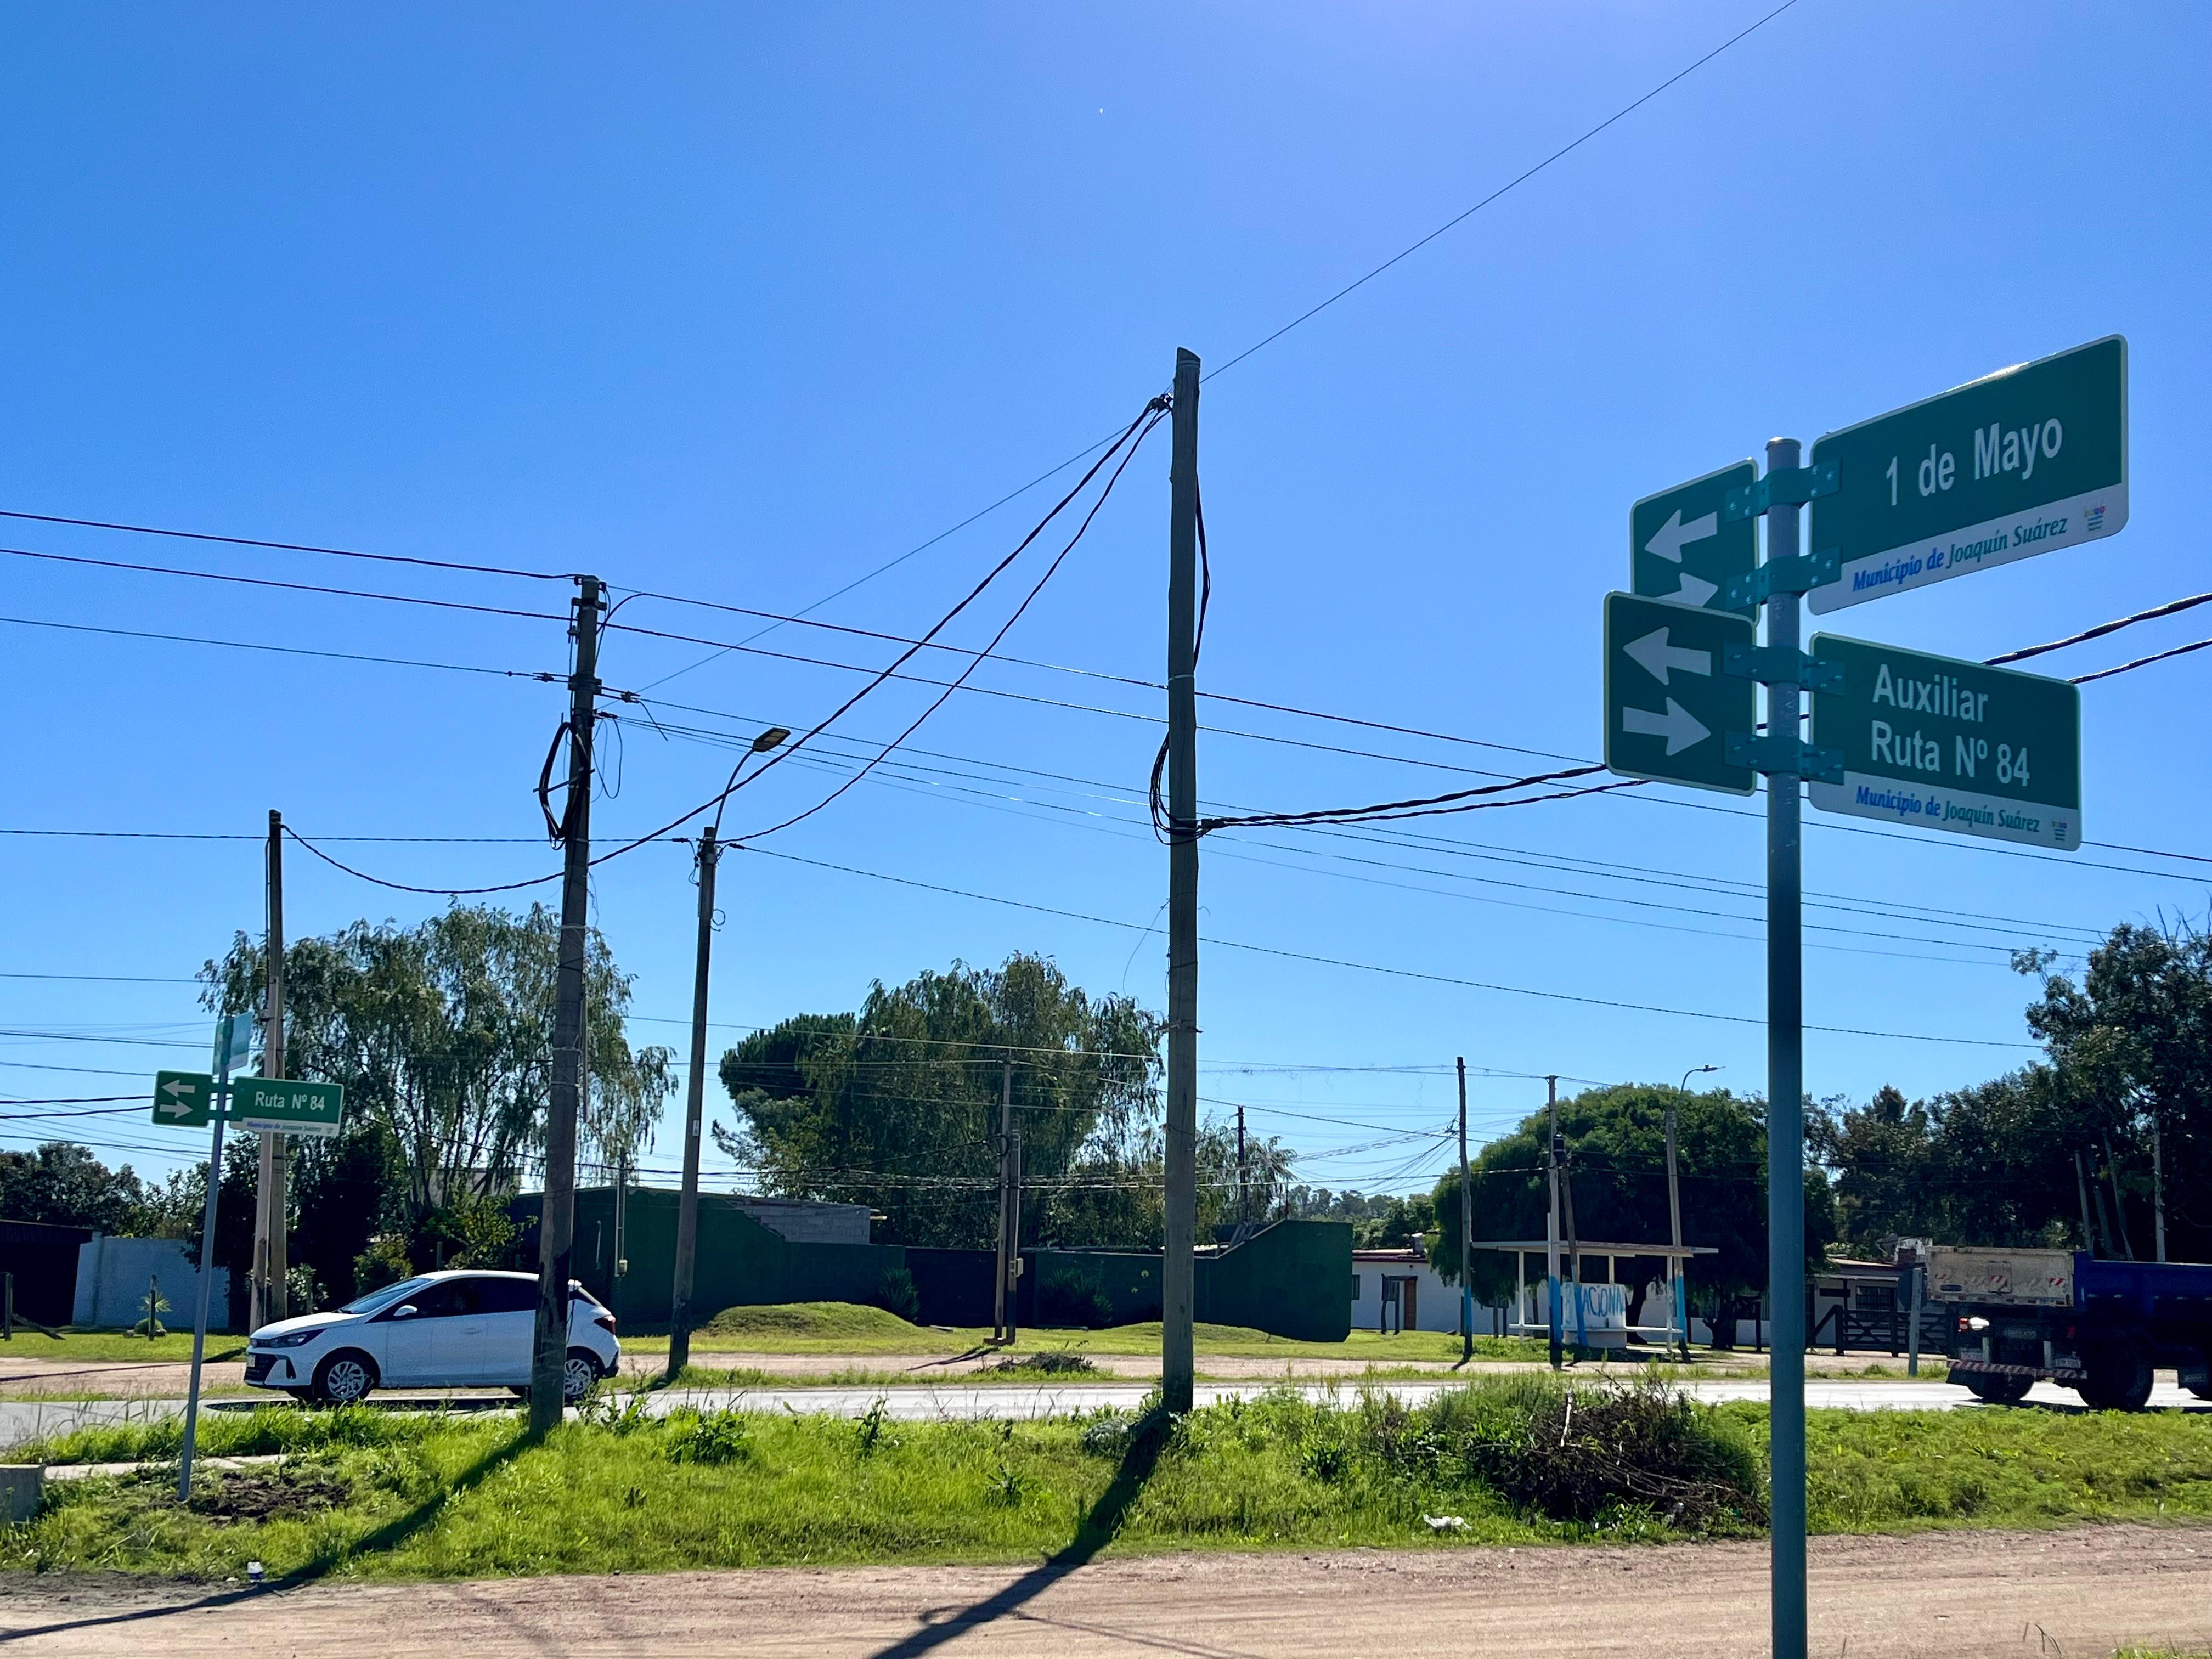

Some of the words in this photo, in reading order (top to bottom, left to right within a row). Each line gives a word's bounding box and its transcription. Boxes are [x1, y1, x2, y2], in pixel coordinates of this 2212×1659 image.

[1886, 456, 1898, 506] 1
[1919, 443, 1955, 496] de
[1974, 417, 2063, 480] Mayo
[1853, 555, 1922, 592] Municipio
[1927, 548, 1945, 570] de
[1946, 529, 2008, 569] Joaquín
[2013, 517, 2068, 547] Suárez
[1872, 664, 1989, 723] Auxiliar
[1871, 720, 1940, 772] Ruta
[1997, 743, 2030, 787] 84
[1856, 785, 1921, 816] Municipio
[1925, 796, 1941, 816] de
[1941, 800, 1995, 827] Joaquín
[1998, 809, 2040, 832] Suárez
[255, 1091, 285, 1108] Ruta
[310, 1096, 325, 1110] 84
